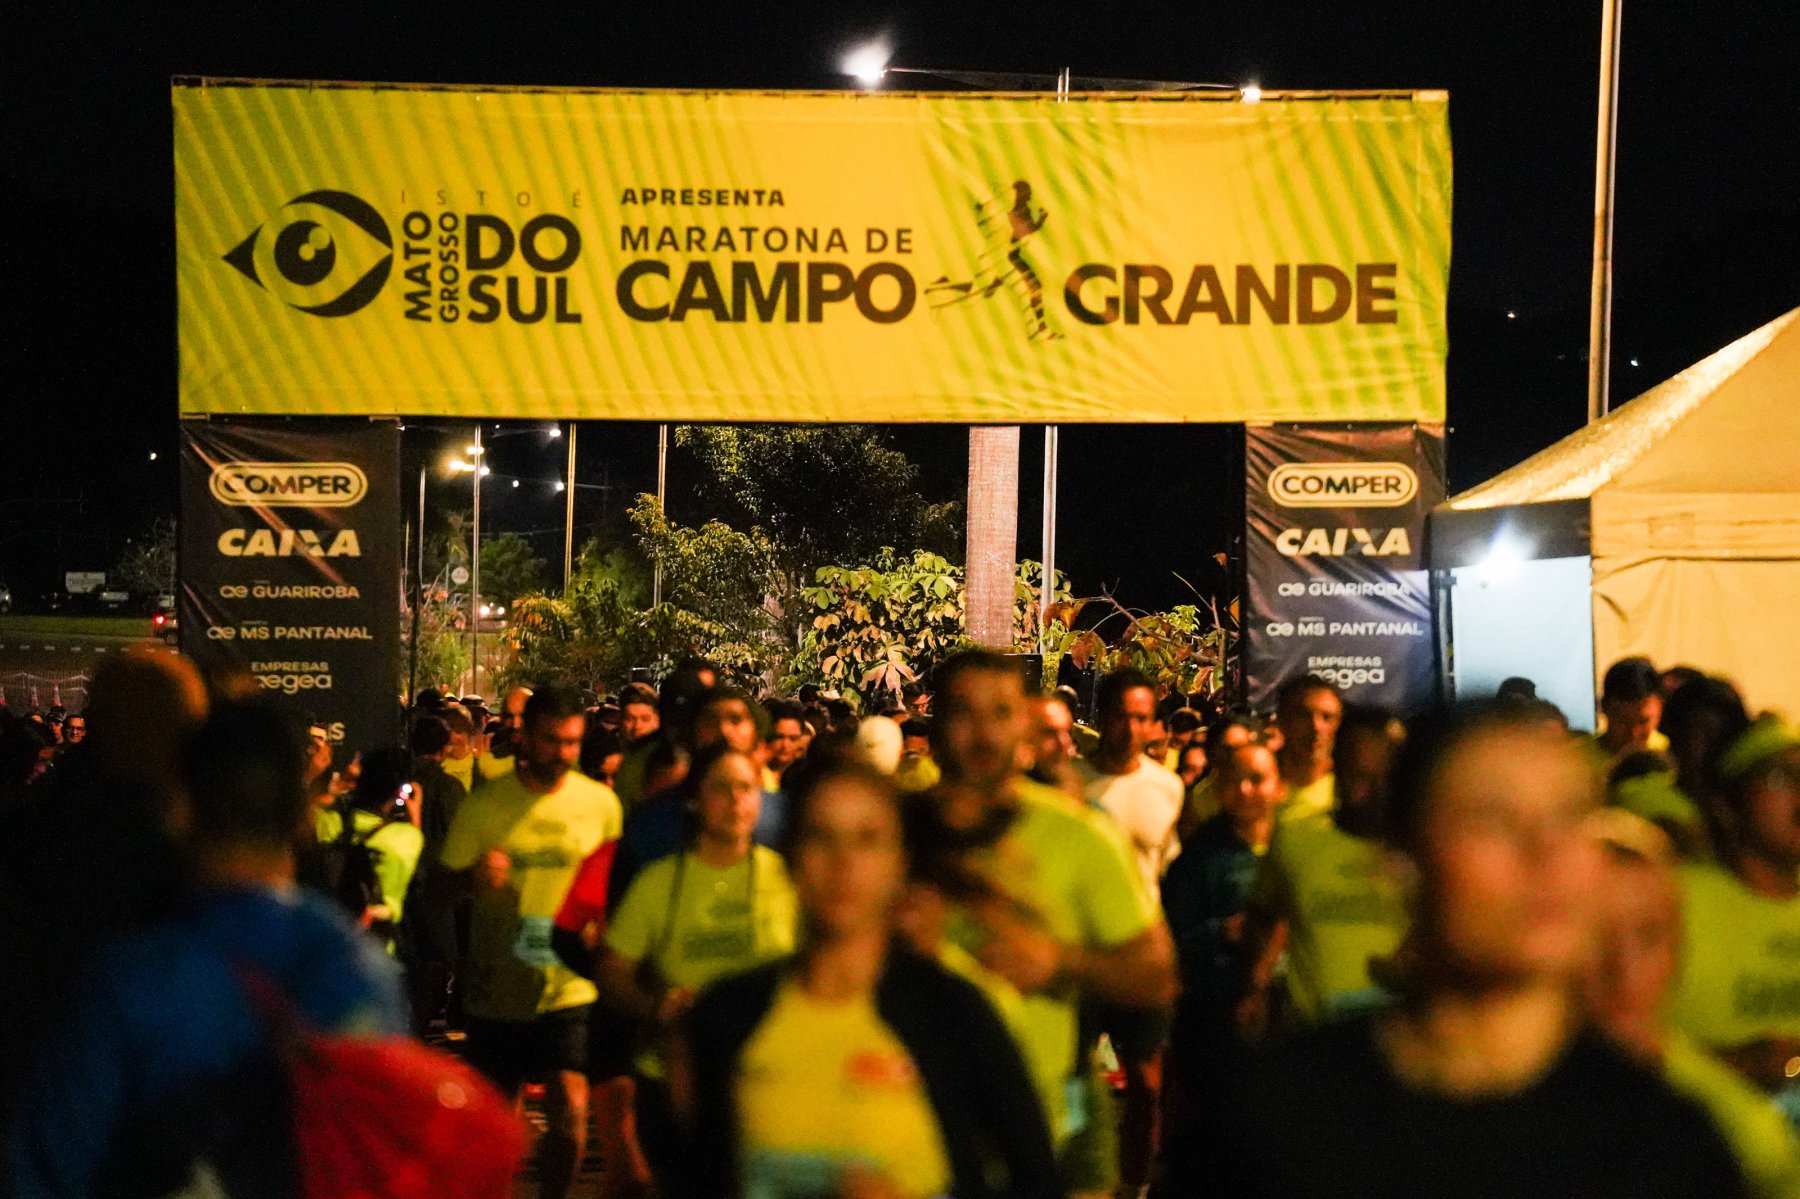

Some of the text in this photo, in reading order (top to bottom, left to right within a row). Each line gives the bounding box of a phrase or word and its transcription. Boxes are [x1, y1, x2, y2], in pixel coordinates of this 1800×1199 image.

[620, 188, 786, 207] APRESENTA
[465, 213, 582, 273] DO
[620, 225, 914, 254] MARATONA DE
[403, 211, 432, 323] MATO
[439, 211, 460, 324] GROSSO
[466, 275, 583, 325] SUL
[615, 259, 1398, 326] CAMPO GRANDE
[223, 474, 352, 495] COMPER
[1282, 475, 1403, 495] COMPER
[217, 528, 362, 557] CAIXA
[1275, 527, 1412, 557] CAIXA
[252, 585, 361, 599] GUARIROBA
[240, 626, 270, 640] MS
[274, 626, 374, 640] PANTANAL
[1298, 622, 1326, 637] MS
[1329, 622, 1424, 637] PANTANAL
[251, 661, 330, 673] EMPRESAS
[1307, 656, 1383, 668] EMPRESAS
